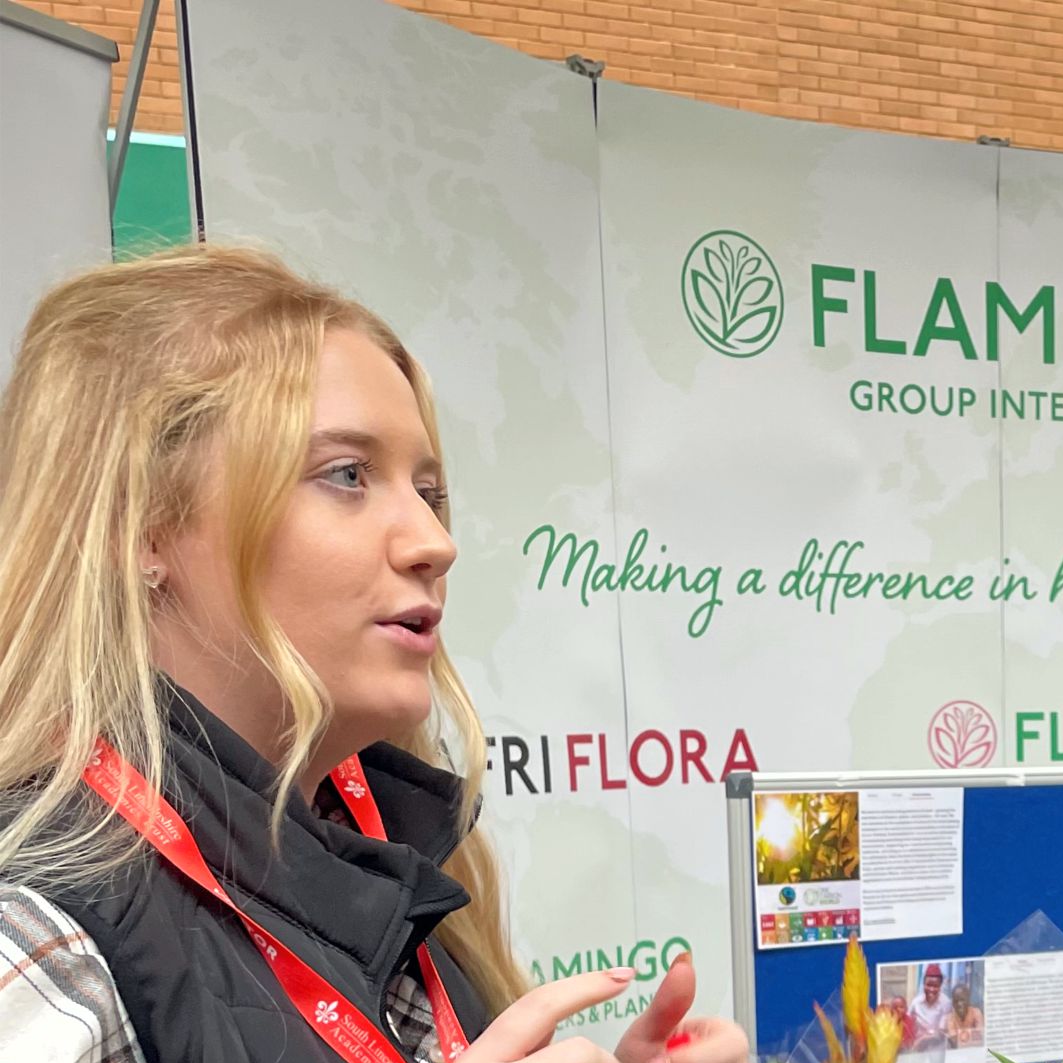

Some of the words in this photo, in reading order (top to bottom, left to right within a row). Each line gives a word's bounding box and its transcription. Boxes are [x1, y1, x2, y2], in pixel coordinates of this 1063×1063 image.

[849, 379, 977, 418] GROUP
[522, 523, 723, 639] Making
[735, 563, 766, 594] a
[777, 537, 975, 615] difference
[988, 557, 1037, 601] in
[341, 1014, 369, 1044] South
